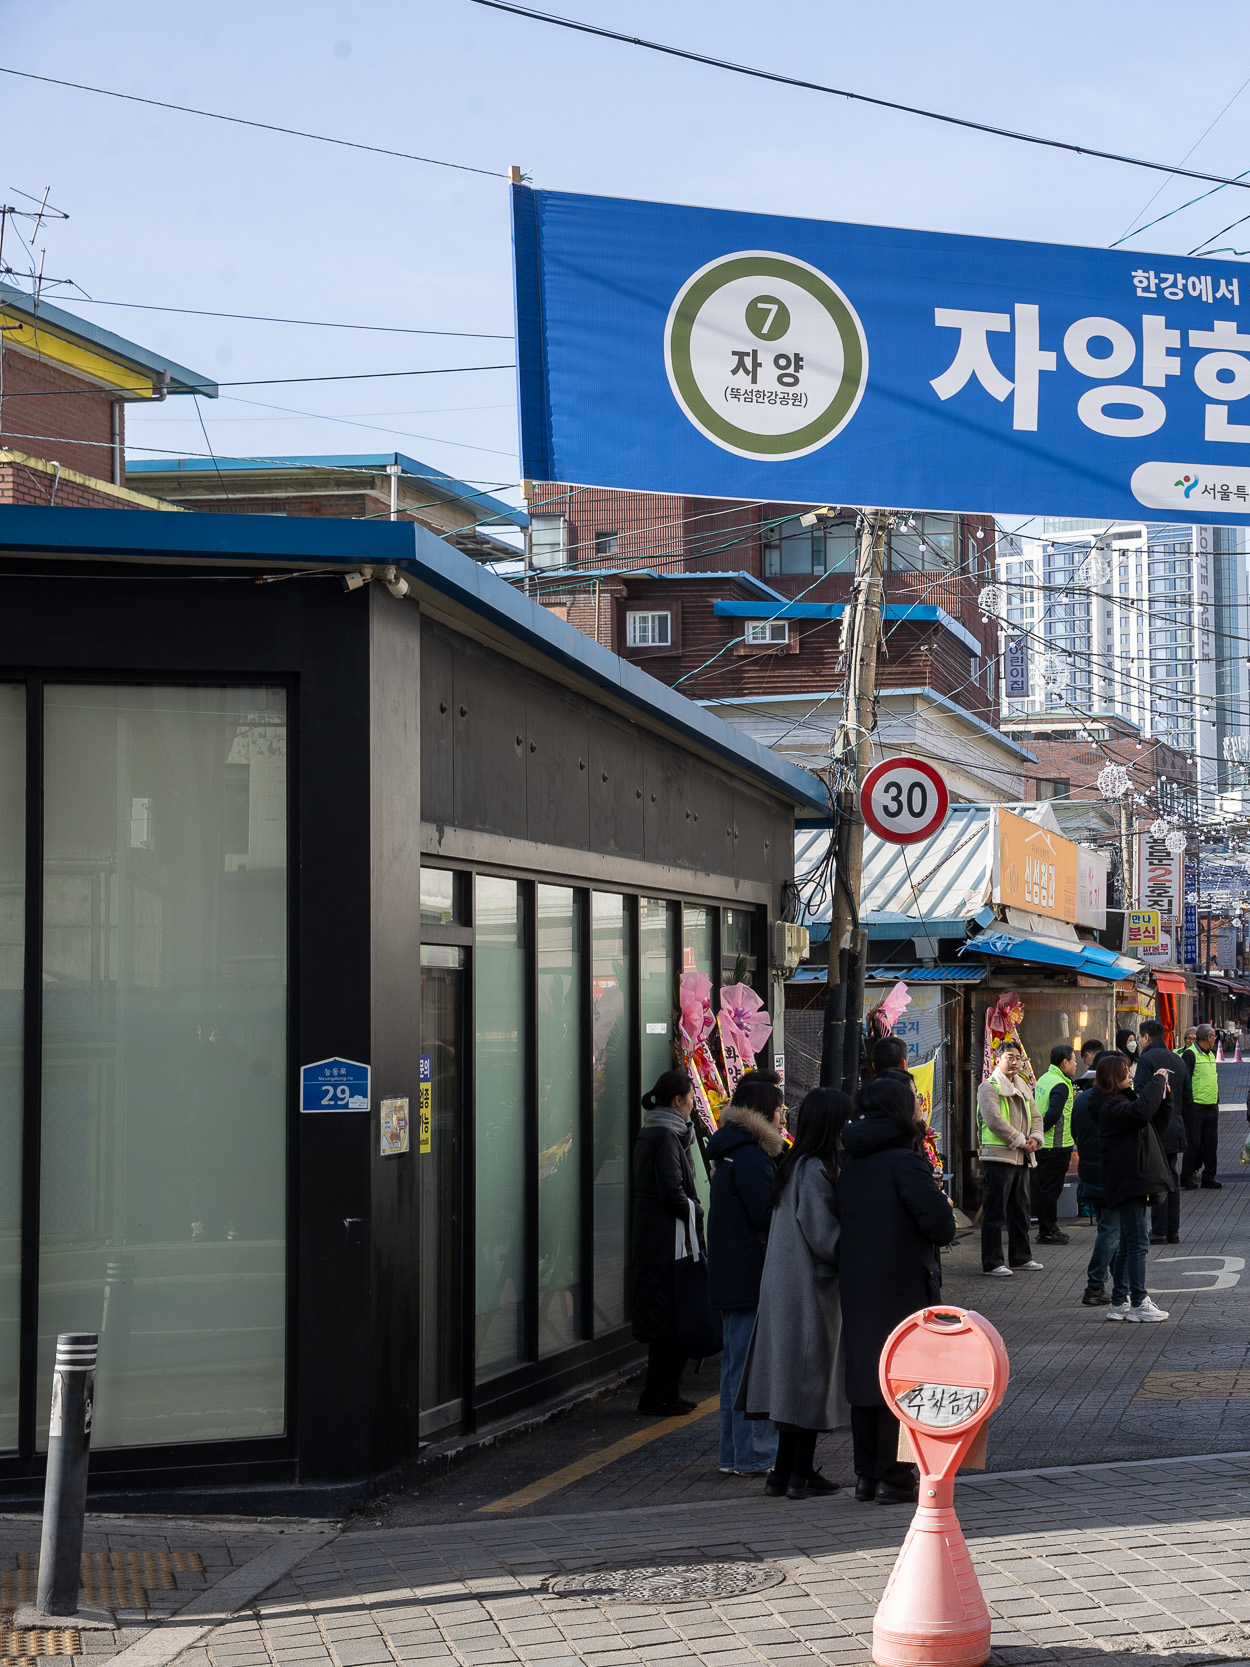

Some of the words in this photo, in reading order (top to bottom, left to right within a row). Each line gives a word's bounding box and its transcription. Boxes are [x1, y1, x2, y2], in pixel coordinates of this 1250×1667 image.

[1131, 269, 1240, 306] 한강에서
[756, 303, 778, 335] 7
[724, 385, 809, 408] (뚝섬한강공원)
[882, 780, 929, 819] 30
[1131, 914, 1152, 924] 만나
[1128, 926, 1156, 941] 분식
[324, 1067, 347, 1076] 능동로
[320, 1085, 350, 1105] 29
[907, 1386, 981, 1421] 주차금지
